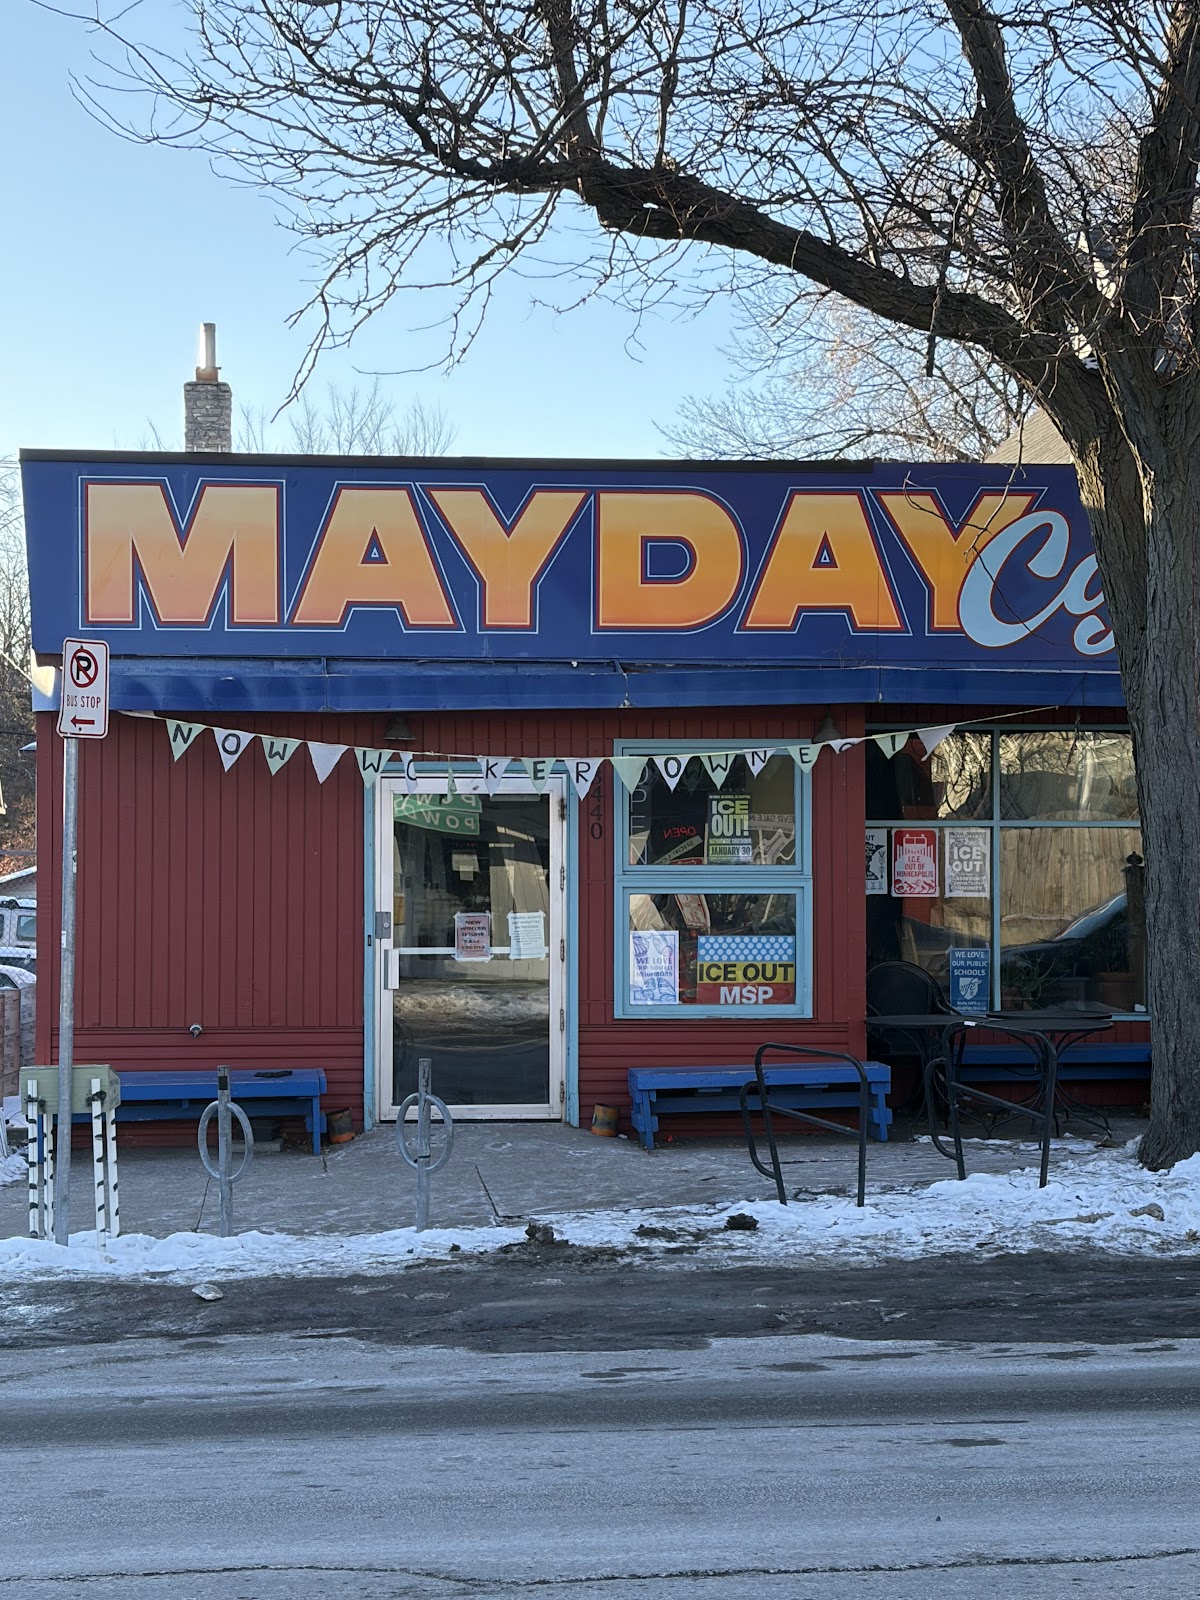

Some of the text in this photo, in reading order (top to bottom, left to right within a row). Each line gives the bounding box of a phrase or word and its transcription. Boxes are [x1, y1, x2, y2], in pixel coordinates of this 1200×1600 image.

[79, 475, 1048, 636] MAYDAY
[66, 694, 102, 709] BUS STOP
[172, 723, 288, 761] NOW
[711, 800, 749, 815] ICE
[711, 814, 749, 837] OUT!
[710, 846, 751, 856] JANUARY 30
[953, 846, 981, 860] ICE
[896, 870, 934, 878] MINNEAPOLIS
[952, 860, 984, 873] OUT
[967, 951, 985, 959] LOVE
[698, 963, 795, 982] ICE OUT
[720, 985, 774, 1005] MSP
